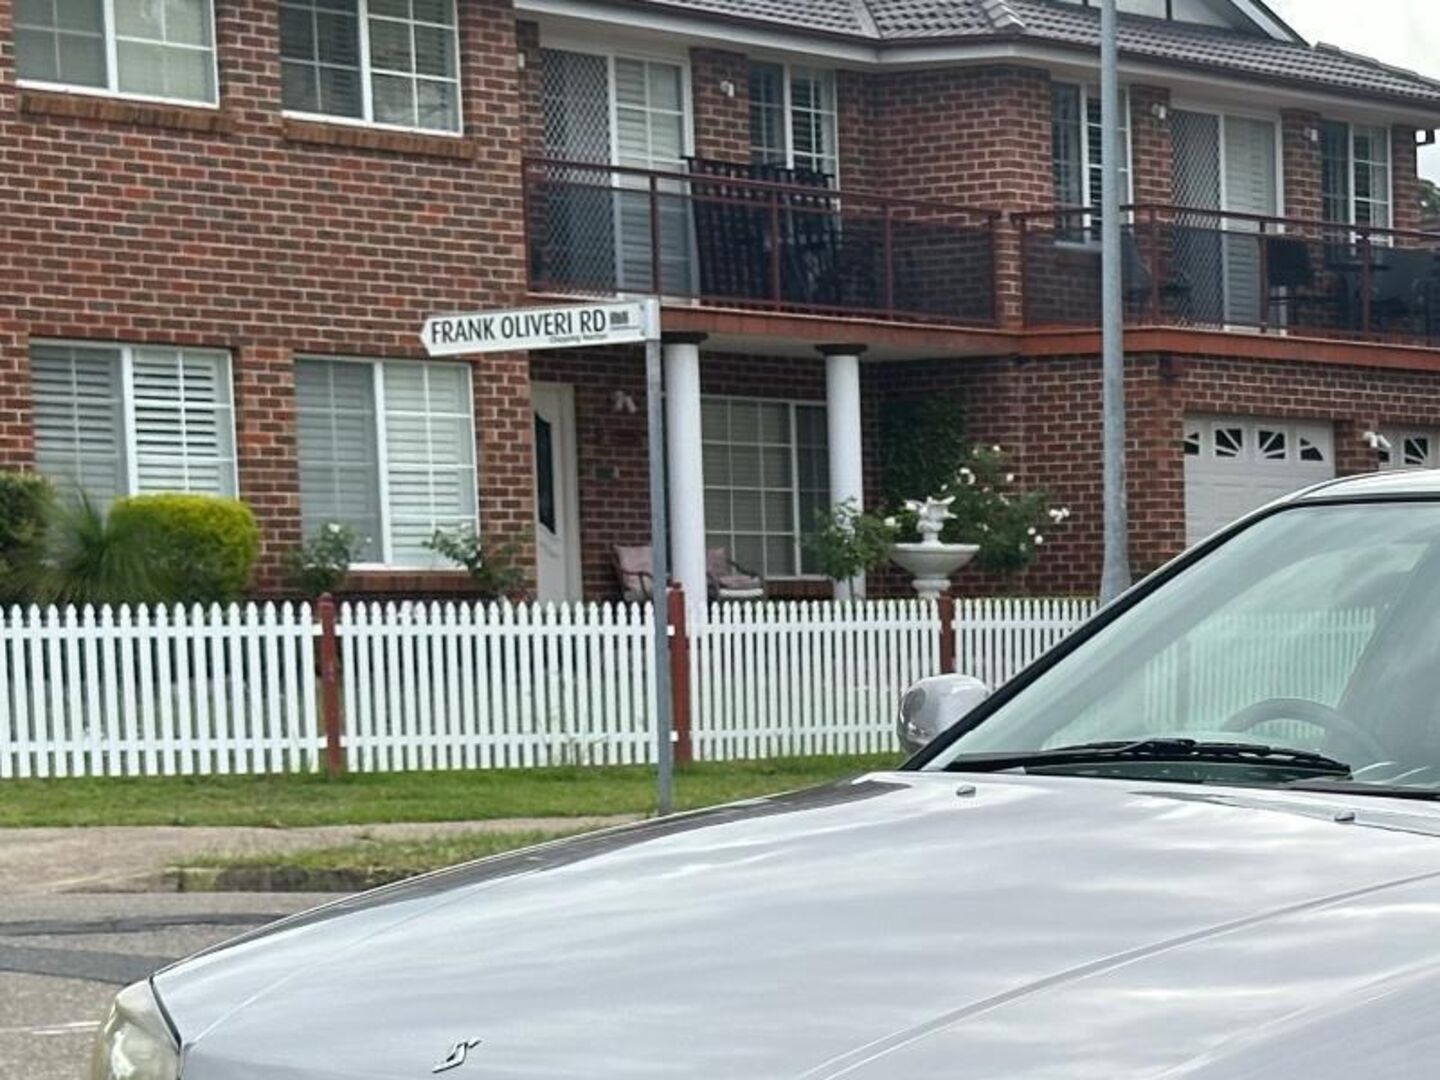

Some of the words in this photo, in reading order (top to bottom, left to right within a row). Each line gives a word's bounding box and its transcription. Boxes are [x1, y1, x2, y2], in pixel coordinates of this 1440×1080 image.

[431, 317, 495, 344] FRANK
[501, 311, 572, 339] OLIVERI
[580, 309, 606, 334] RD
